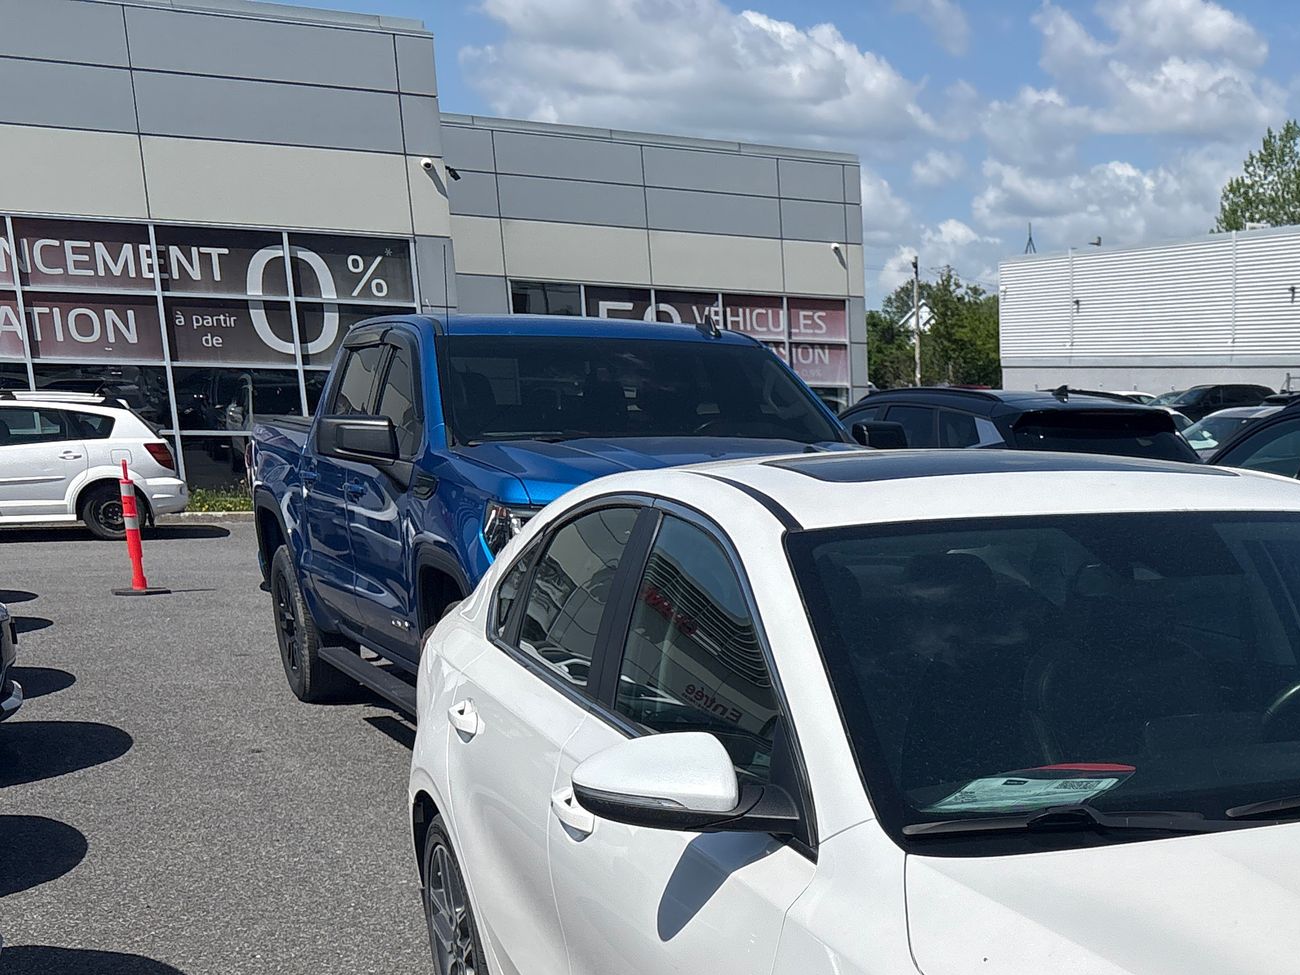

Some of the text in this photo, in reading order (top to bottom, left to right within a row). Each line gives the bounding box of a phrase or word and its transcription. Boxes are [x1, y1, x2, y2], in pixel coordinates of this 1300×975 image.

[0, 305, 138, 344] ATION
[175, 311, 237, 330] à partir
[202, 333, 223, 348] de
[767, 342, 829, 365] ION
